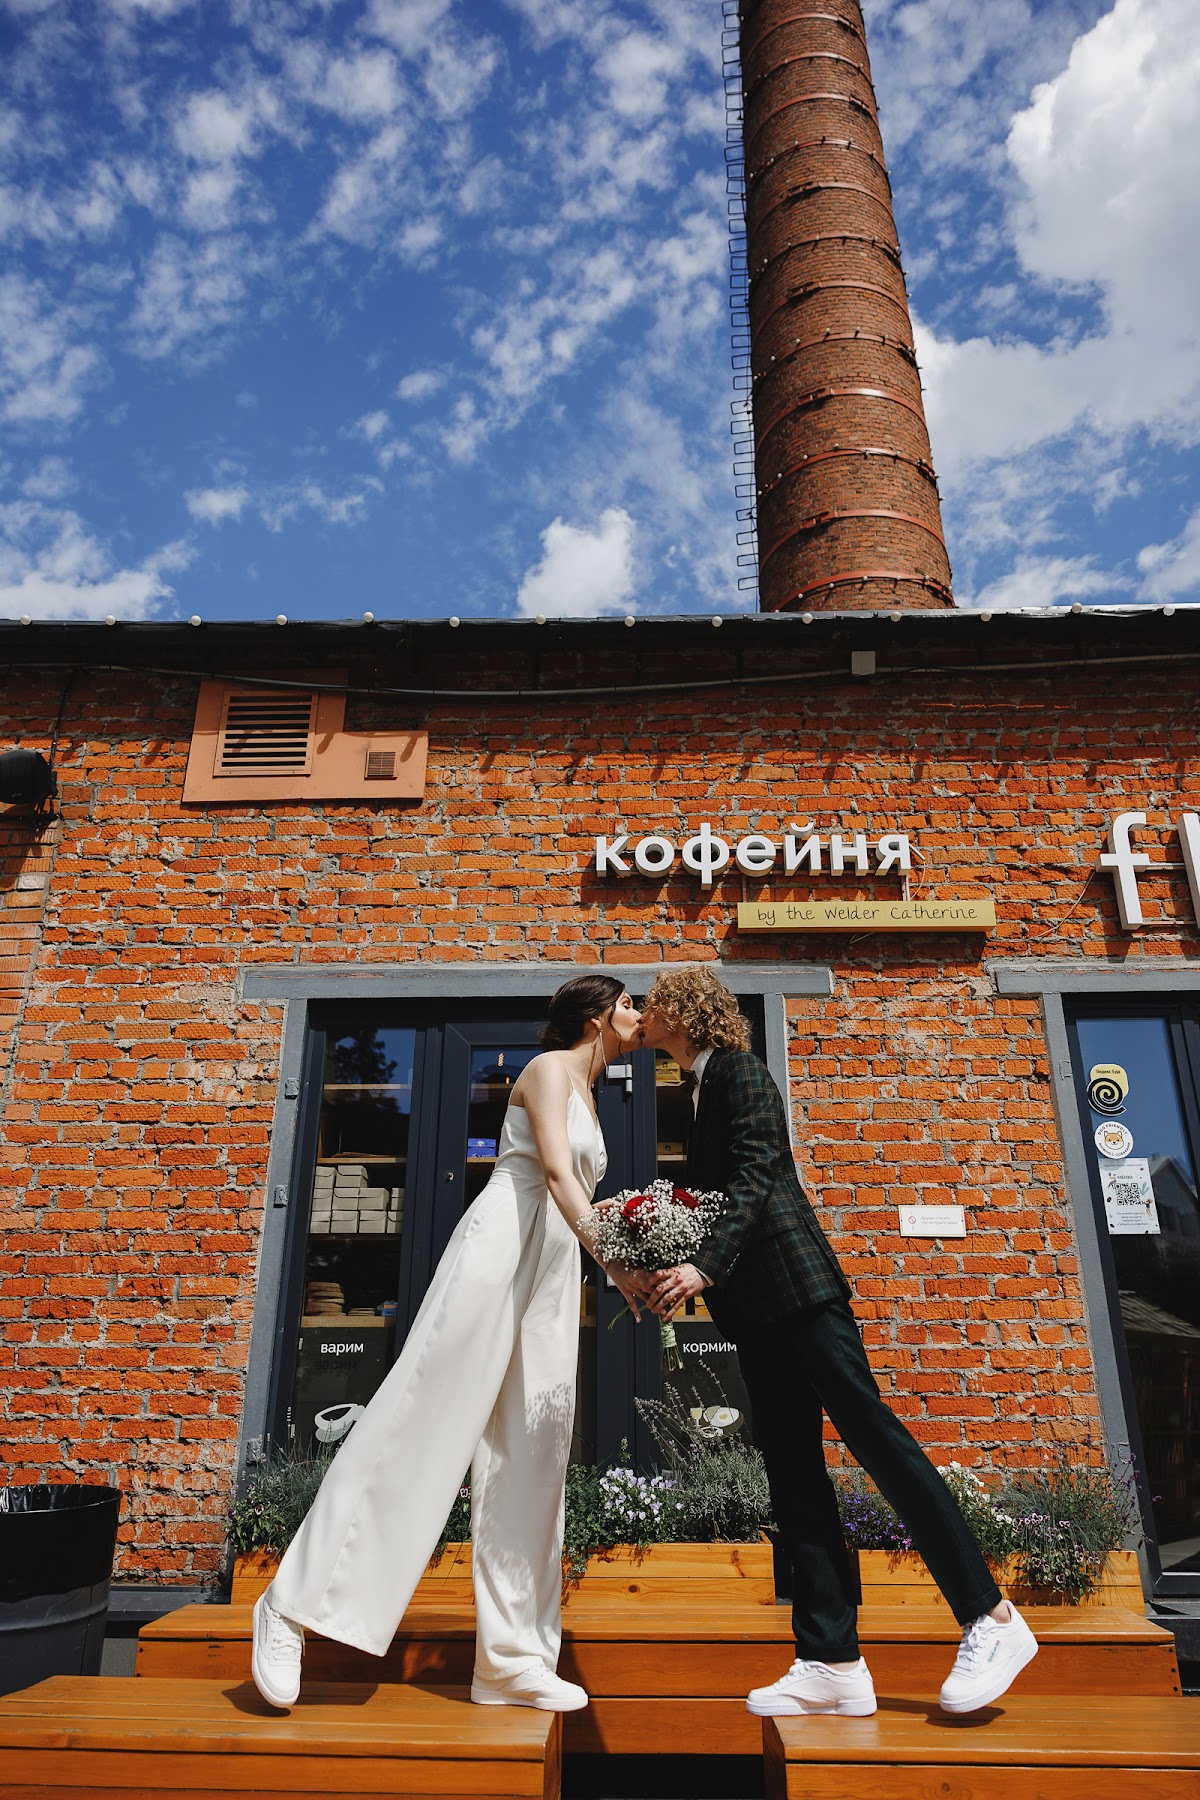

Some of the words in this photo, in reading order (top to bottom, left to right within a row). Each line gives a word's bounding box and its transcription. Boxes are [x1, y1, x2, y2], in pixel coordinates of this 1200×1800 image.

[596, 822, 911, 889] кофейня
[757, 908, 776, 926] by
[786, 905, 815, 920] the
[824, 906, 880, 920] Welder
[890, 903, 978, 920] Catherine
[320, 1342, 365, 1356] варим
[682, 1342, 738, 1356] кормим
